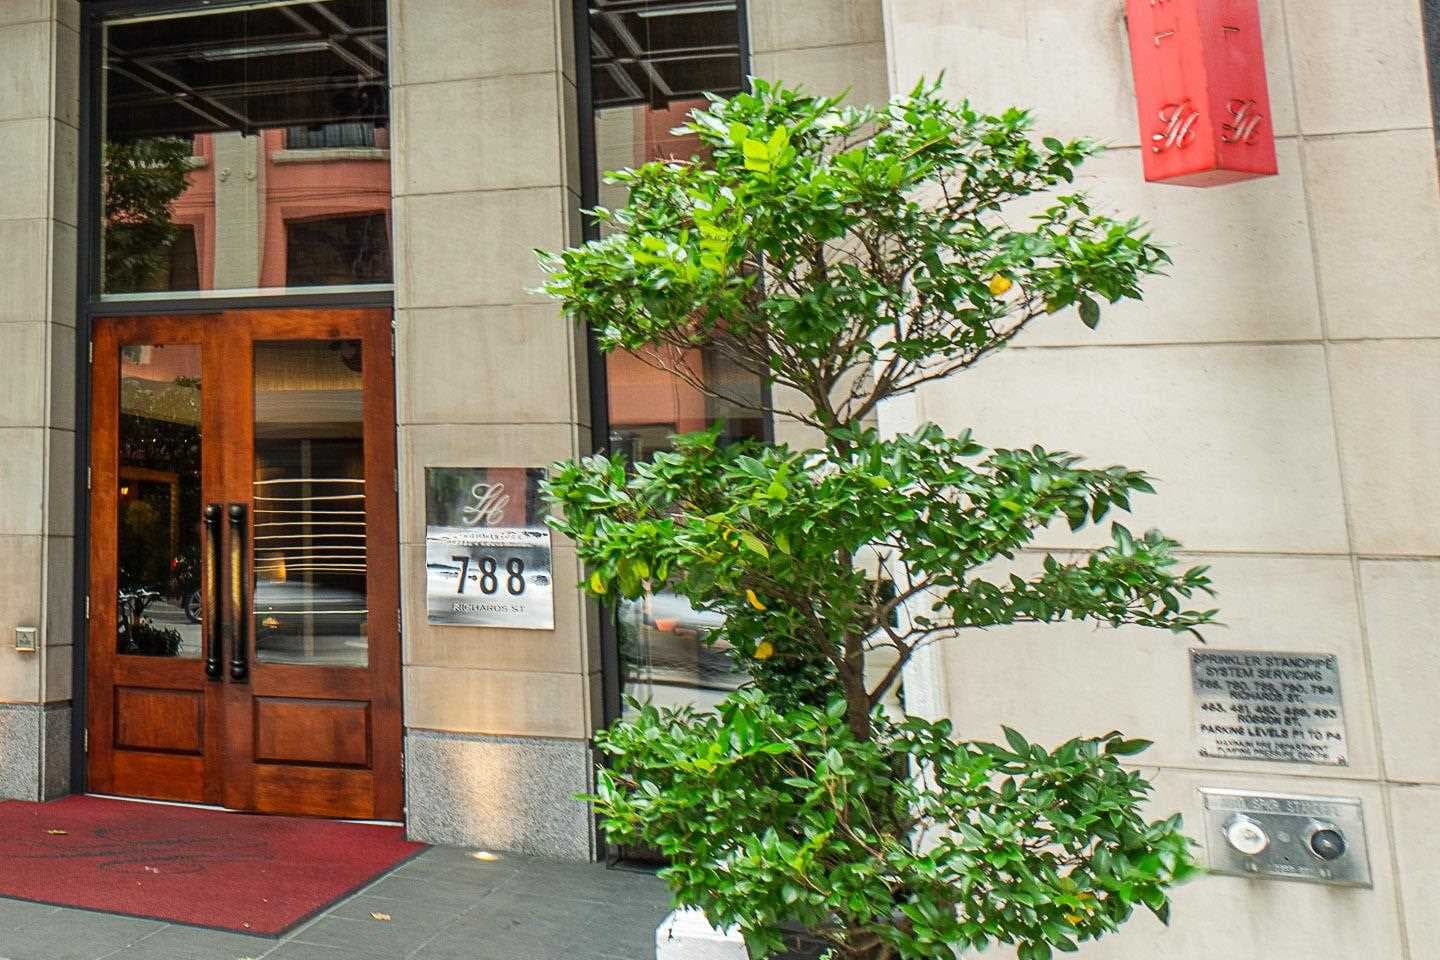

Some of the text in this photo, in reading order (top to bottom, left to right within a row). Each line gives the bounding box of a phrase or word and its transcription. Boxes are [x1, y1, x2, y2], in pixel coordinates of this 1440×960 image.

[452, 555, 525, 596] 788
[1192, 652, 1334, 669] SPRINKLER STANDPIPE
[1205, 665, 1323, 682] SYSTEM SERVICING
[1247, 726, 1289, 739] LEVELS
[1307, 728, 1323, 740] TO
